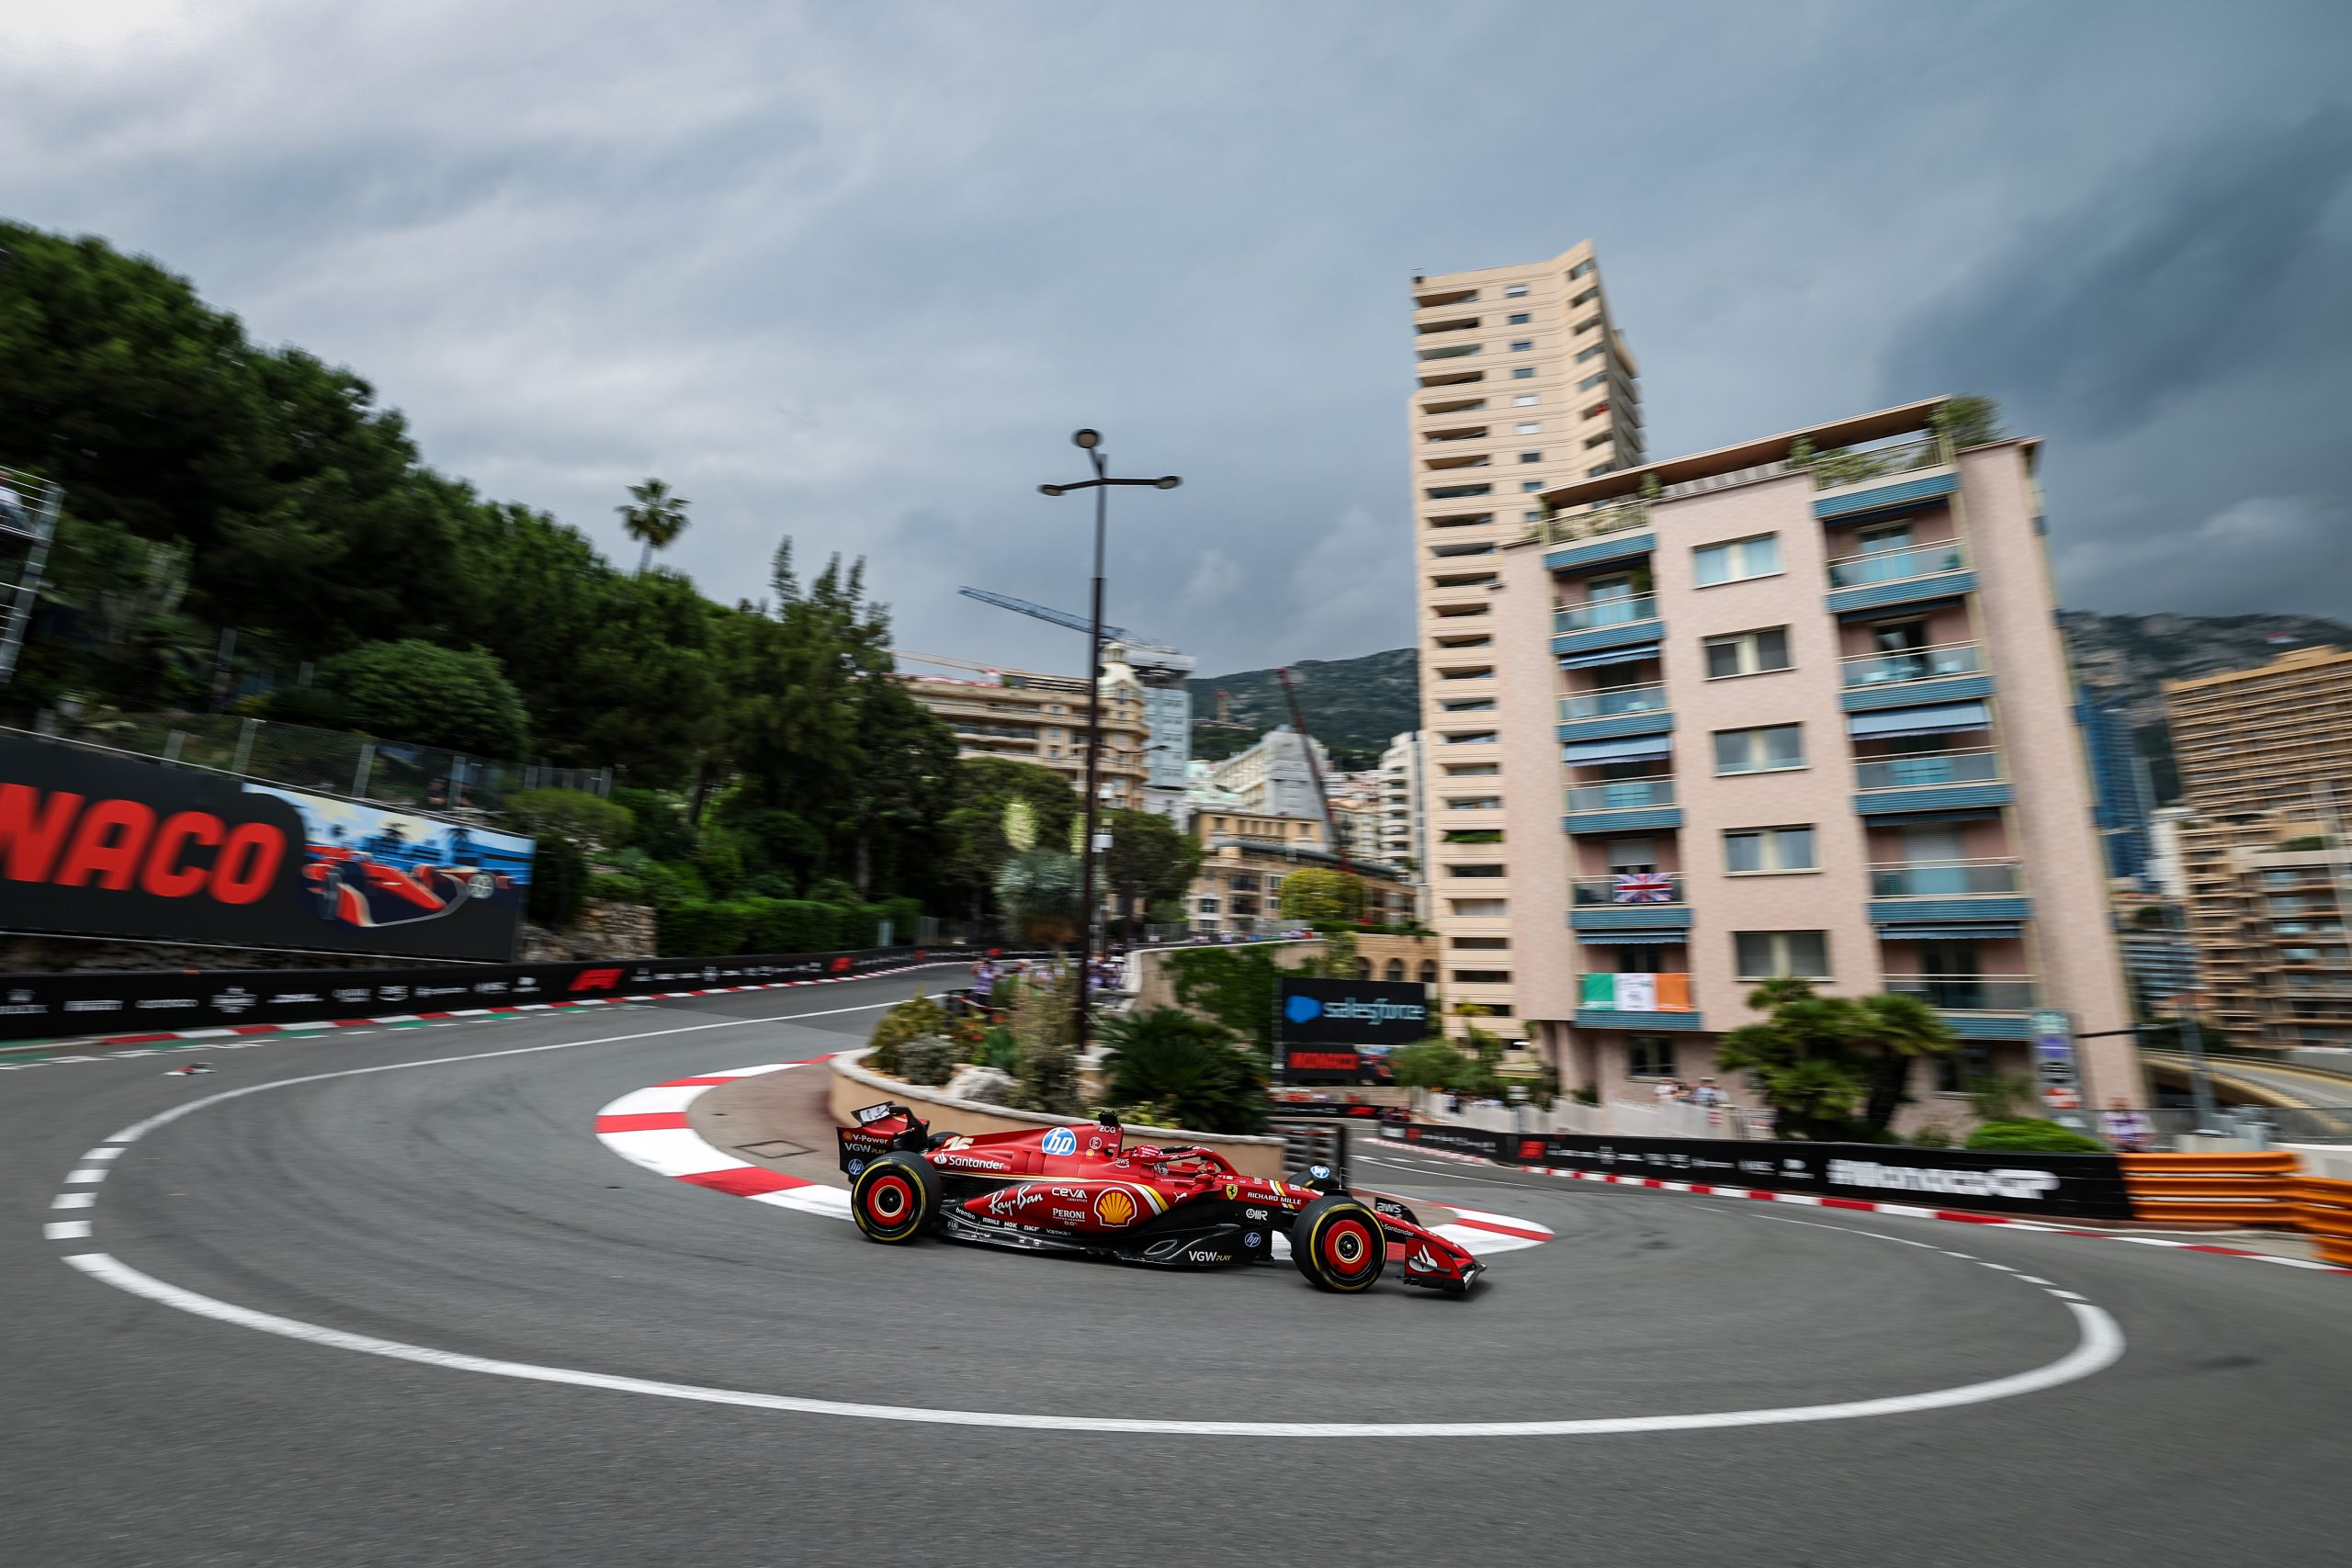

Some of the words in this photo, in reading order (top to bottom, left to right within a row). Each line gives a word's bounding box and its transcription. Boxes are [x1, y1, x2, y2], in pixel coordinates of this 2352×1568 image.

[0, 783, 287, 905] NACO
[853, 1134, 888, 1145] V-Power
[1046, 1126, 1075, 1156] hp
[844, 1143, 871, 1153] VGW
[850, 1160, 862, 1174] hp
[948, 1156, 1004, 1170] Santander
[1247, 1191, 1278, 1201] RICHARD
[1280, 1196, 1302, 1205] MILLE
[956, 1206, 976, 1220] brembo
[1052, 1207, 1085, 1220] PERONI
[1377, 1202, 1402, 1213] aws
[948, 1221, 957, 1229] FIA
[1384, 1224, 1414, 1236] Santander
[1246, 1233, 1260, 1247] hp
[1189, 1250, 1217, 1262] VGW
